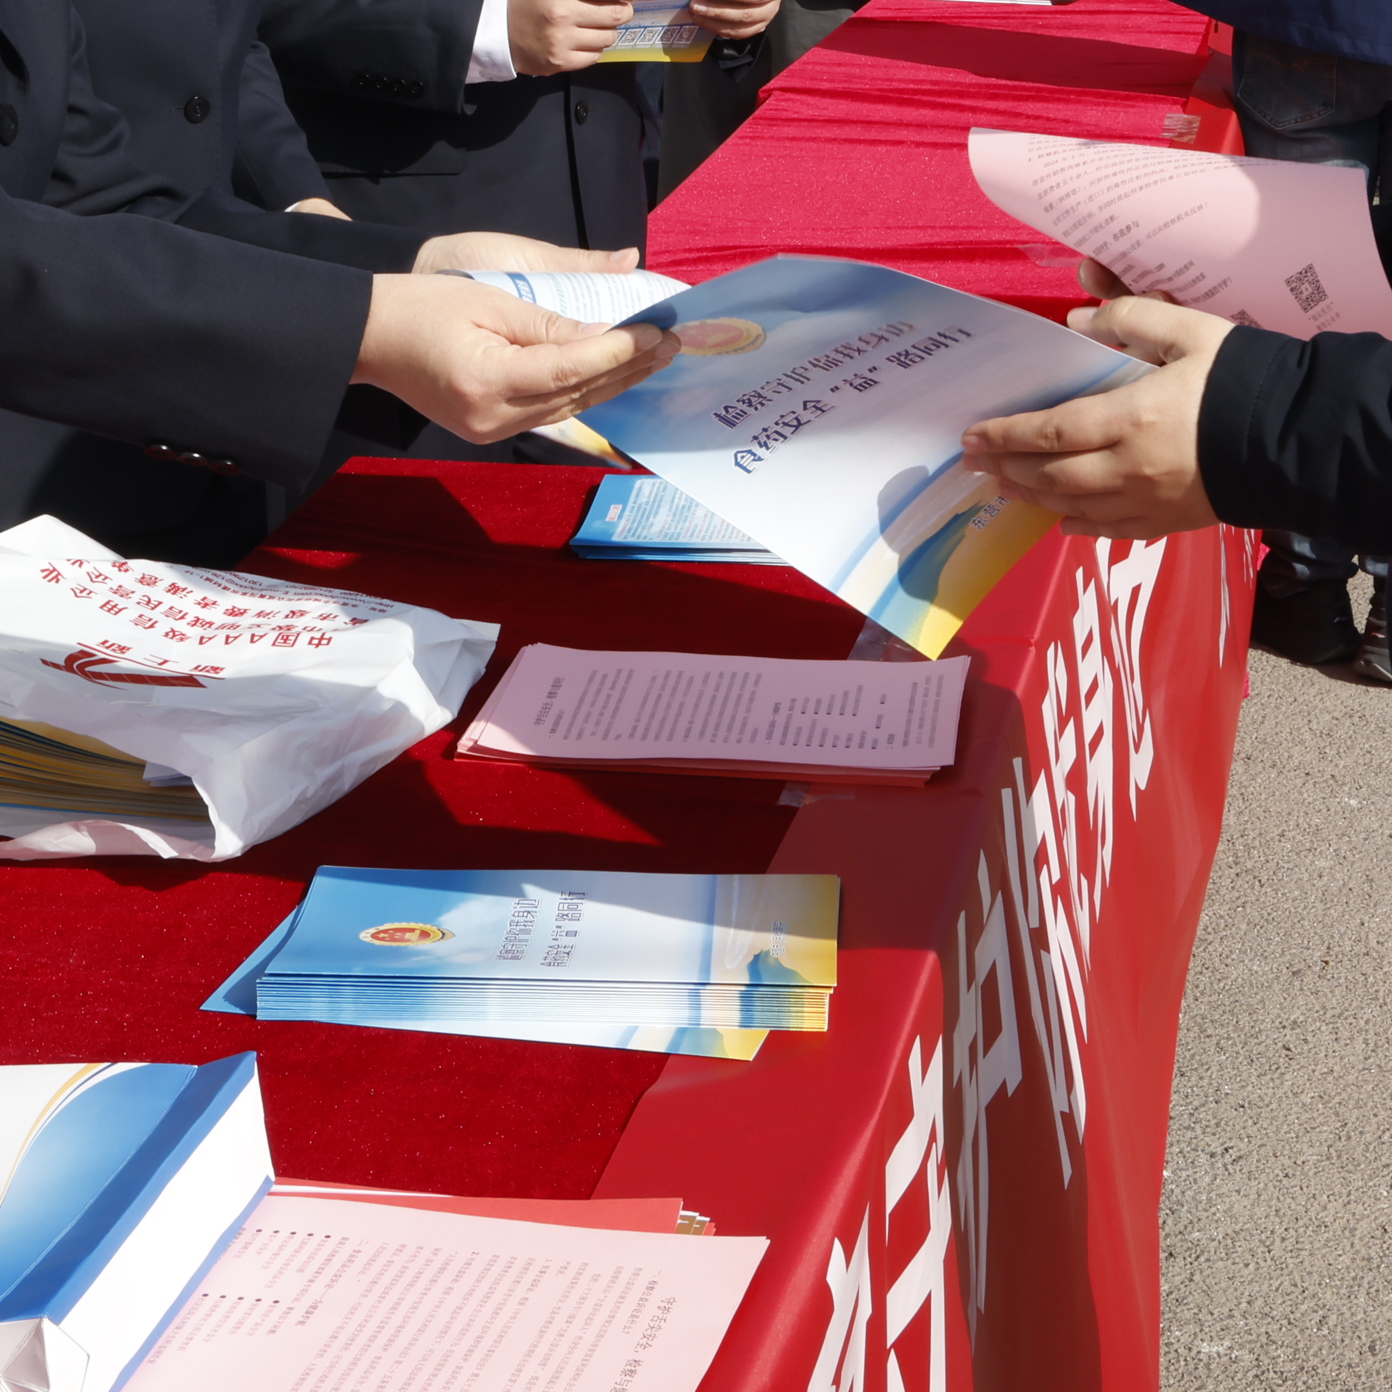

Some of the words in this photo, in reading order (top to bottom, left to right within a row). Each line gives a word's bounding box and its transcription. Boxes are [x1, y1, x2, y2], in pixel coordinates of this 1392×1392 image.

[713, 321, 916, 429] 检察守护你我身边
